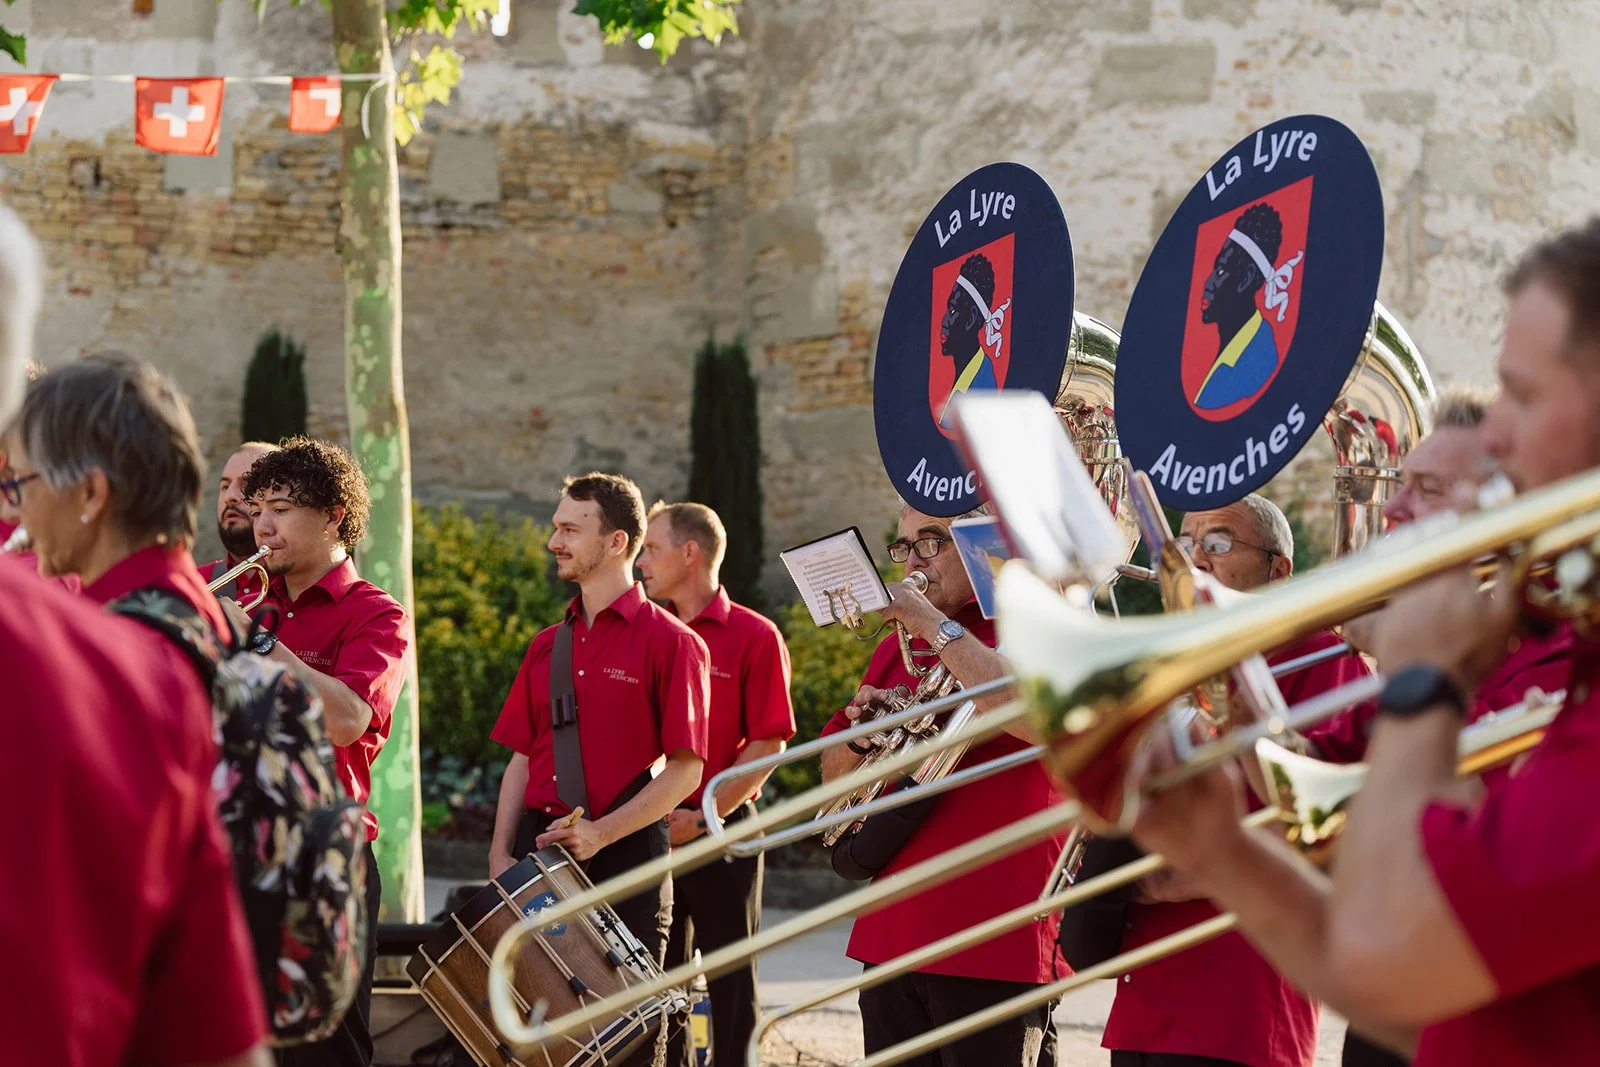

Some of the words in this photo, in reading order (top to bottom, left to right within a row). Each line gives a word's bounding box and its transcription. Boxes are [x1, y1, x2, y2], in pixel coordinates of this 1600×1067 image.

[1205, 155, 1242, 201] La
[1253, 130, 1318, 173] Lyre
[934, 209, 962, 248] La
[970, 188, 1016, 227] Lyre
[1149, 402, 1306, 495] Avenches
[906, 457, 981, 501] Avenc
[609, 674, 639, 684] AVENCHES
